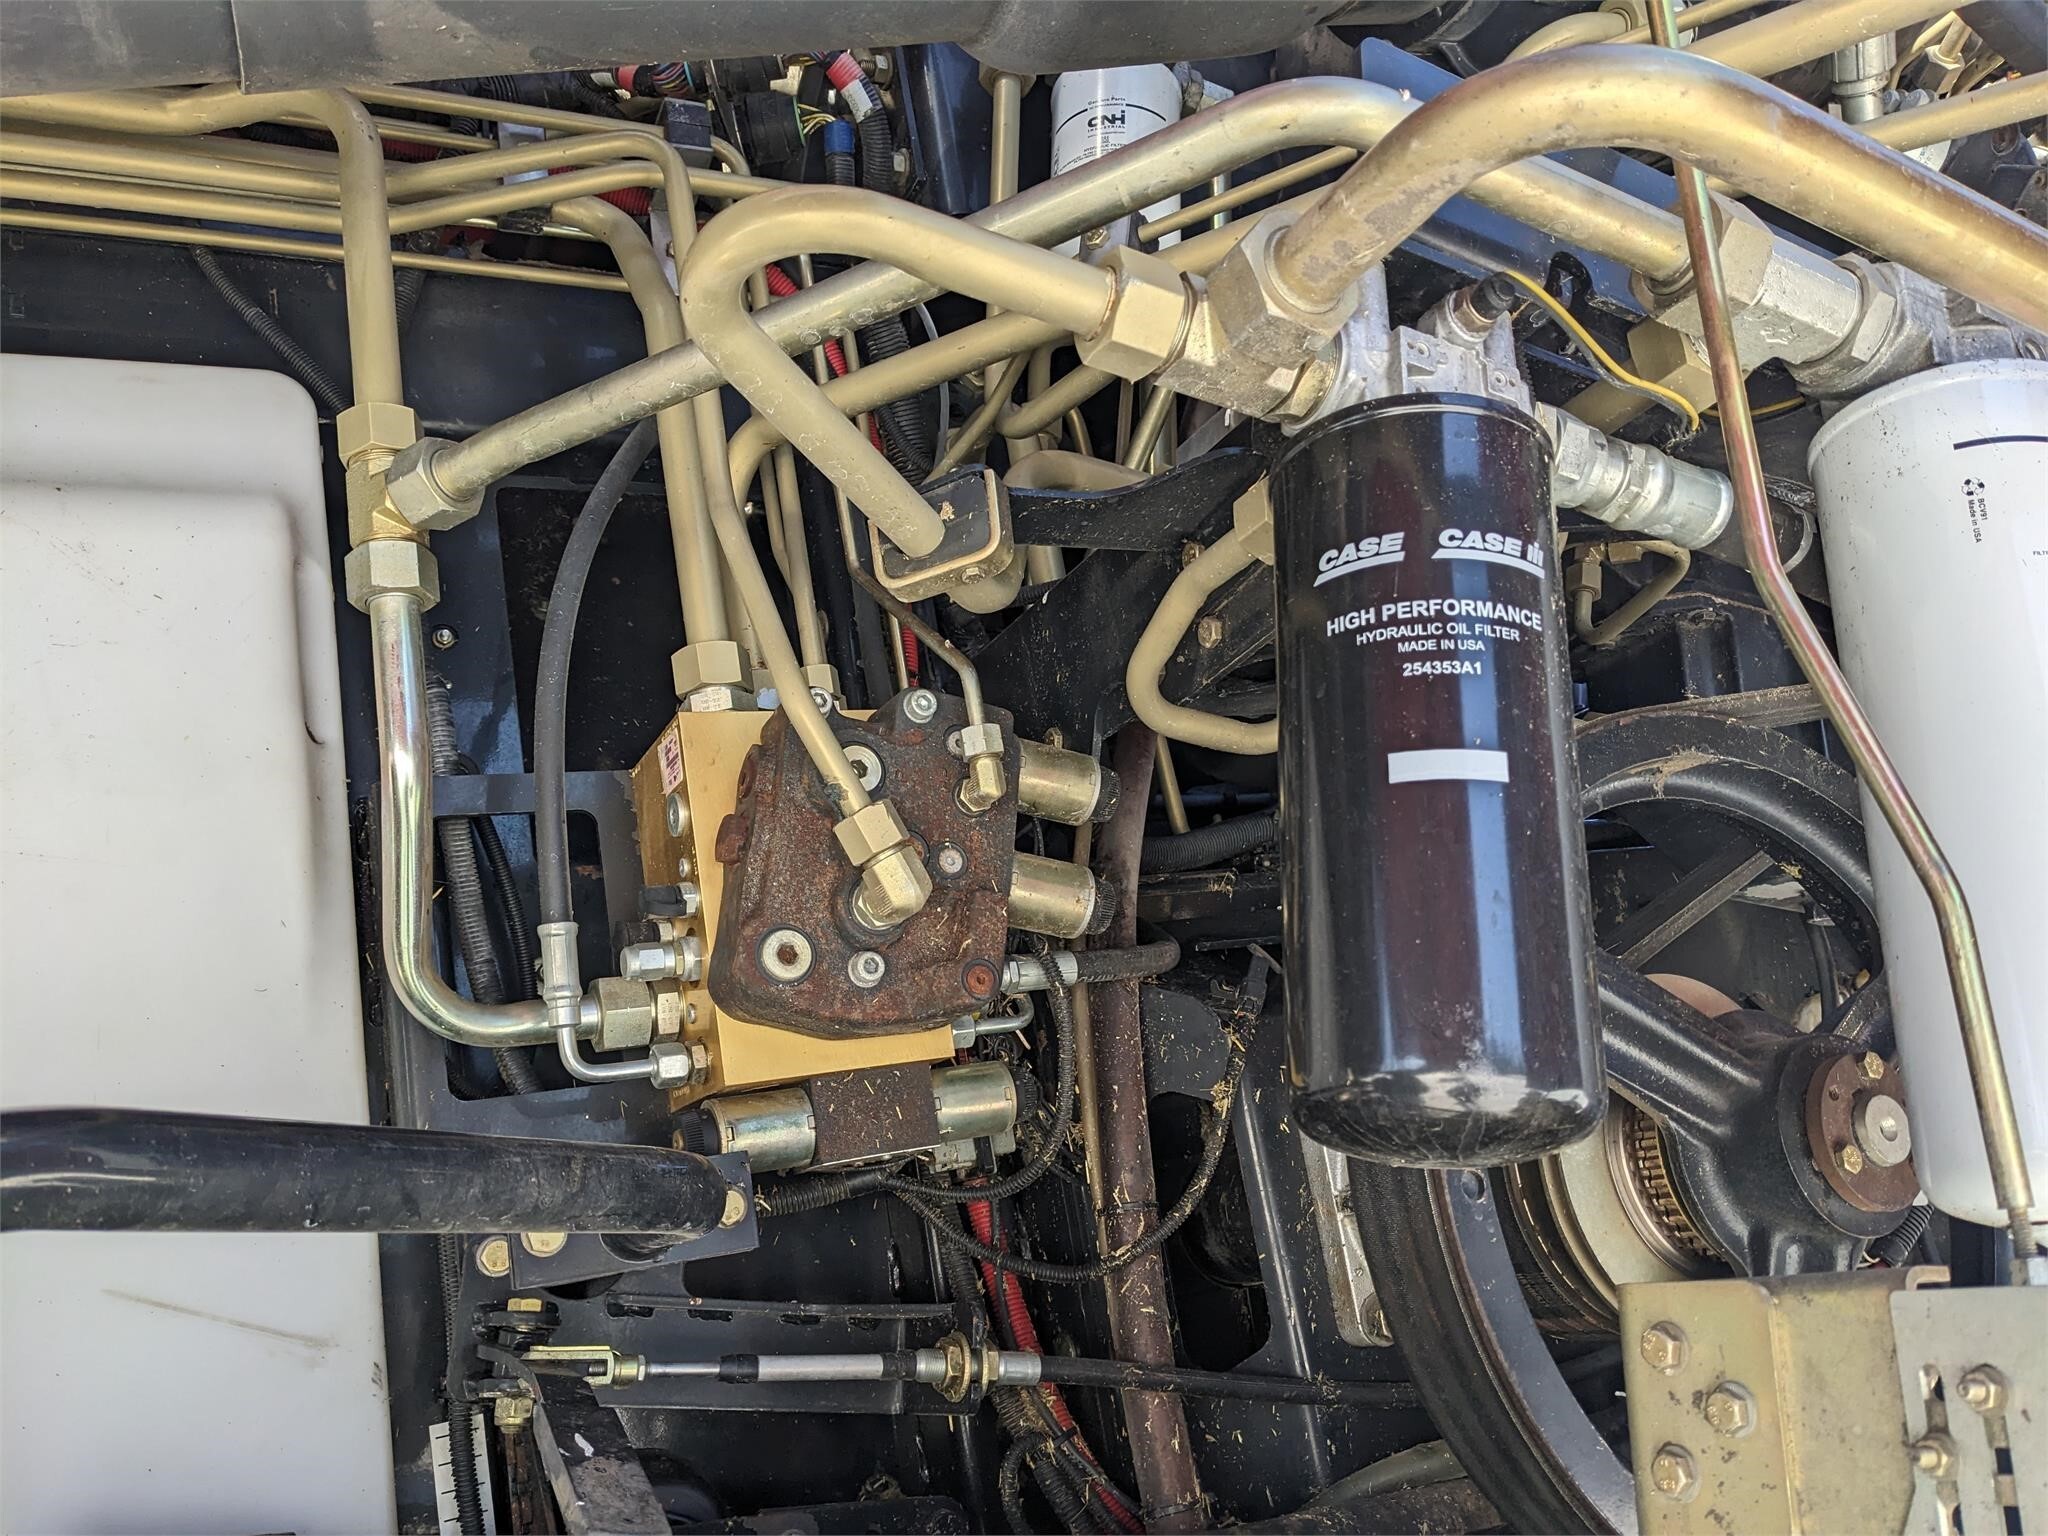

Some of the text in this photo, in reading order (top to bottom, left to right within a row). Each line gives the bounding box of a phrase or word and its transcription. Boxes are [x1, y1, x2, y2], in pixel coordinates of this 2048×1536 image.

[1087, 125, 1126, 133] INDSTRIAL
[1968, 499, 1976, 518] Made
[1973, 527, 1982, 543] USA
[1318, 532, 1405, 572] CASE
[1438, 529, 1522, 557] CASE
[1326, 599, 1543, 637] HIGH PERFORMANCE
[1356, 622, 1521, 646] HYDRAULIC OIL FILTER
[1397, 639, 1486, 654] MADE IN USA
[1402, 660, 1482, 677] 254353A1
